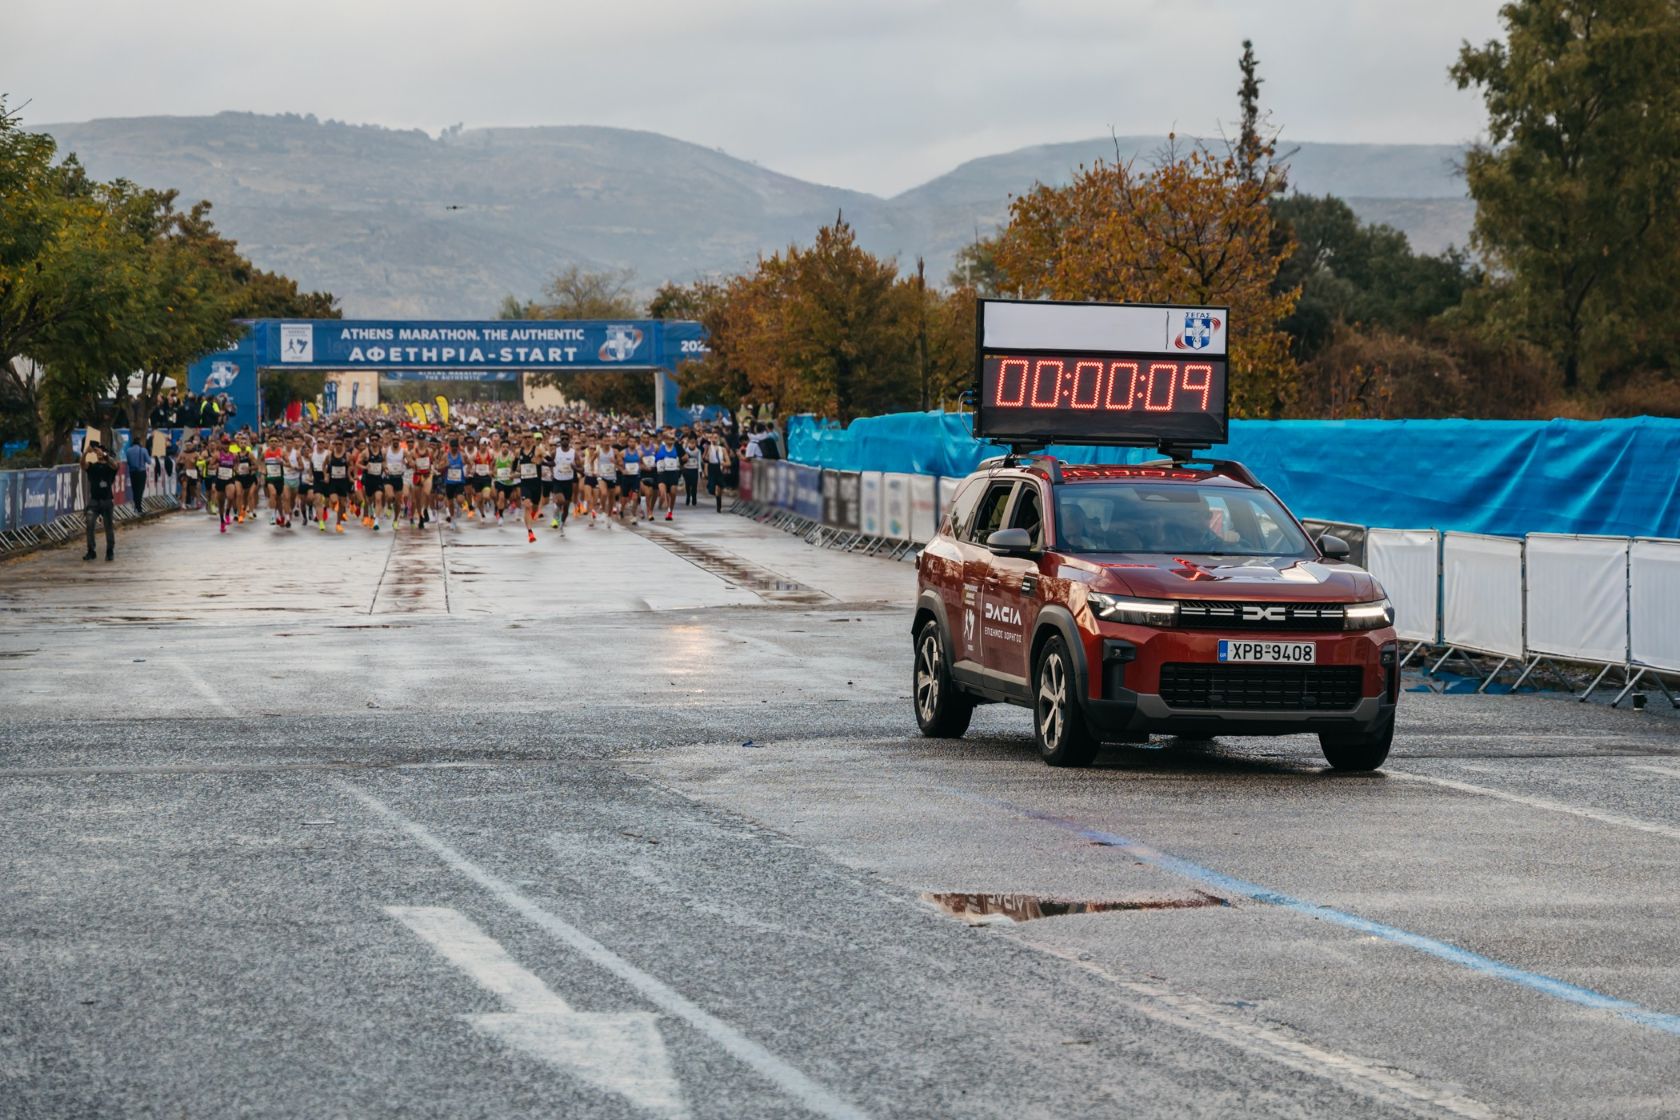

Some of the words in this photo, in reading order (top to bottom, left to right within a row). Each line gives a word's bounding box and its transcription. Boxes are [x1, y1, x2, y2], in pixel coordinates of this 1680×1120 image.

[341, 328, 394, 340] ATHENS
[399, 328, 480, 340] MARATHON.
[482, 328, 508, 340] THE
[511, 328, 584, 341] AUTHENTIC
[680, 340, 712, 353] 202
[995, 359, 1213, 411] 00:00:09
[985, 603, 1022, 626] DACIA
